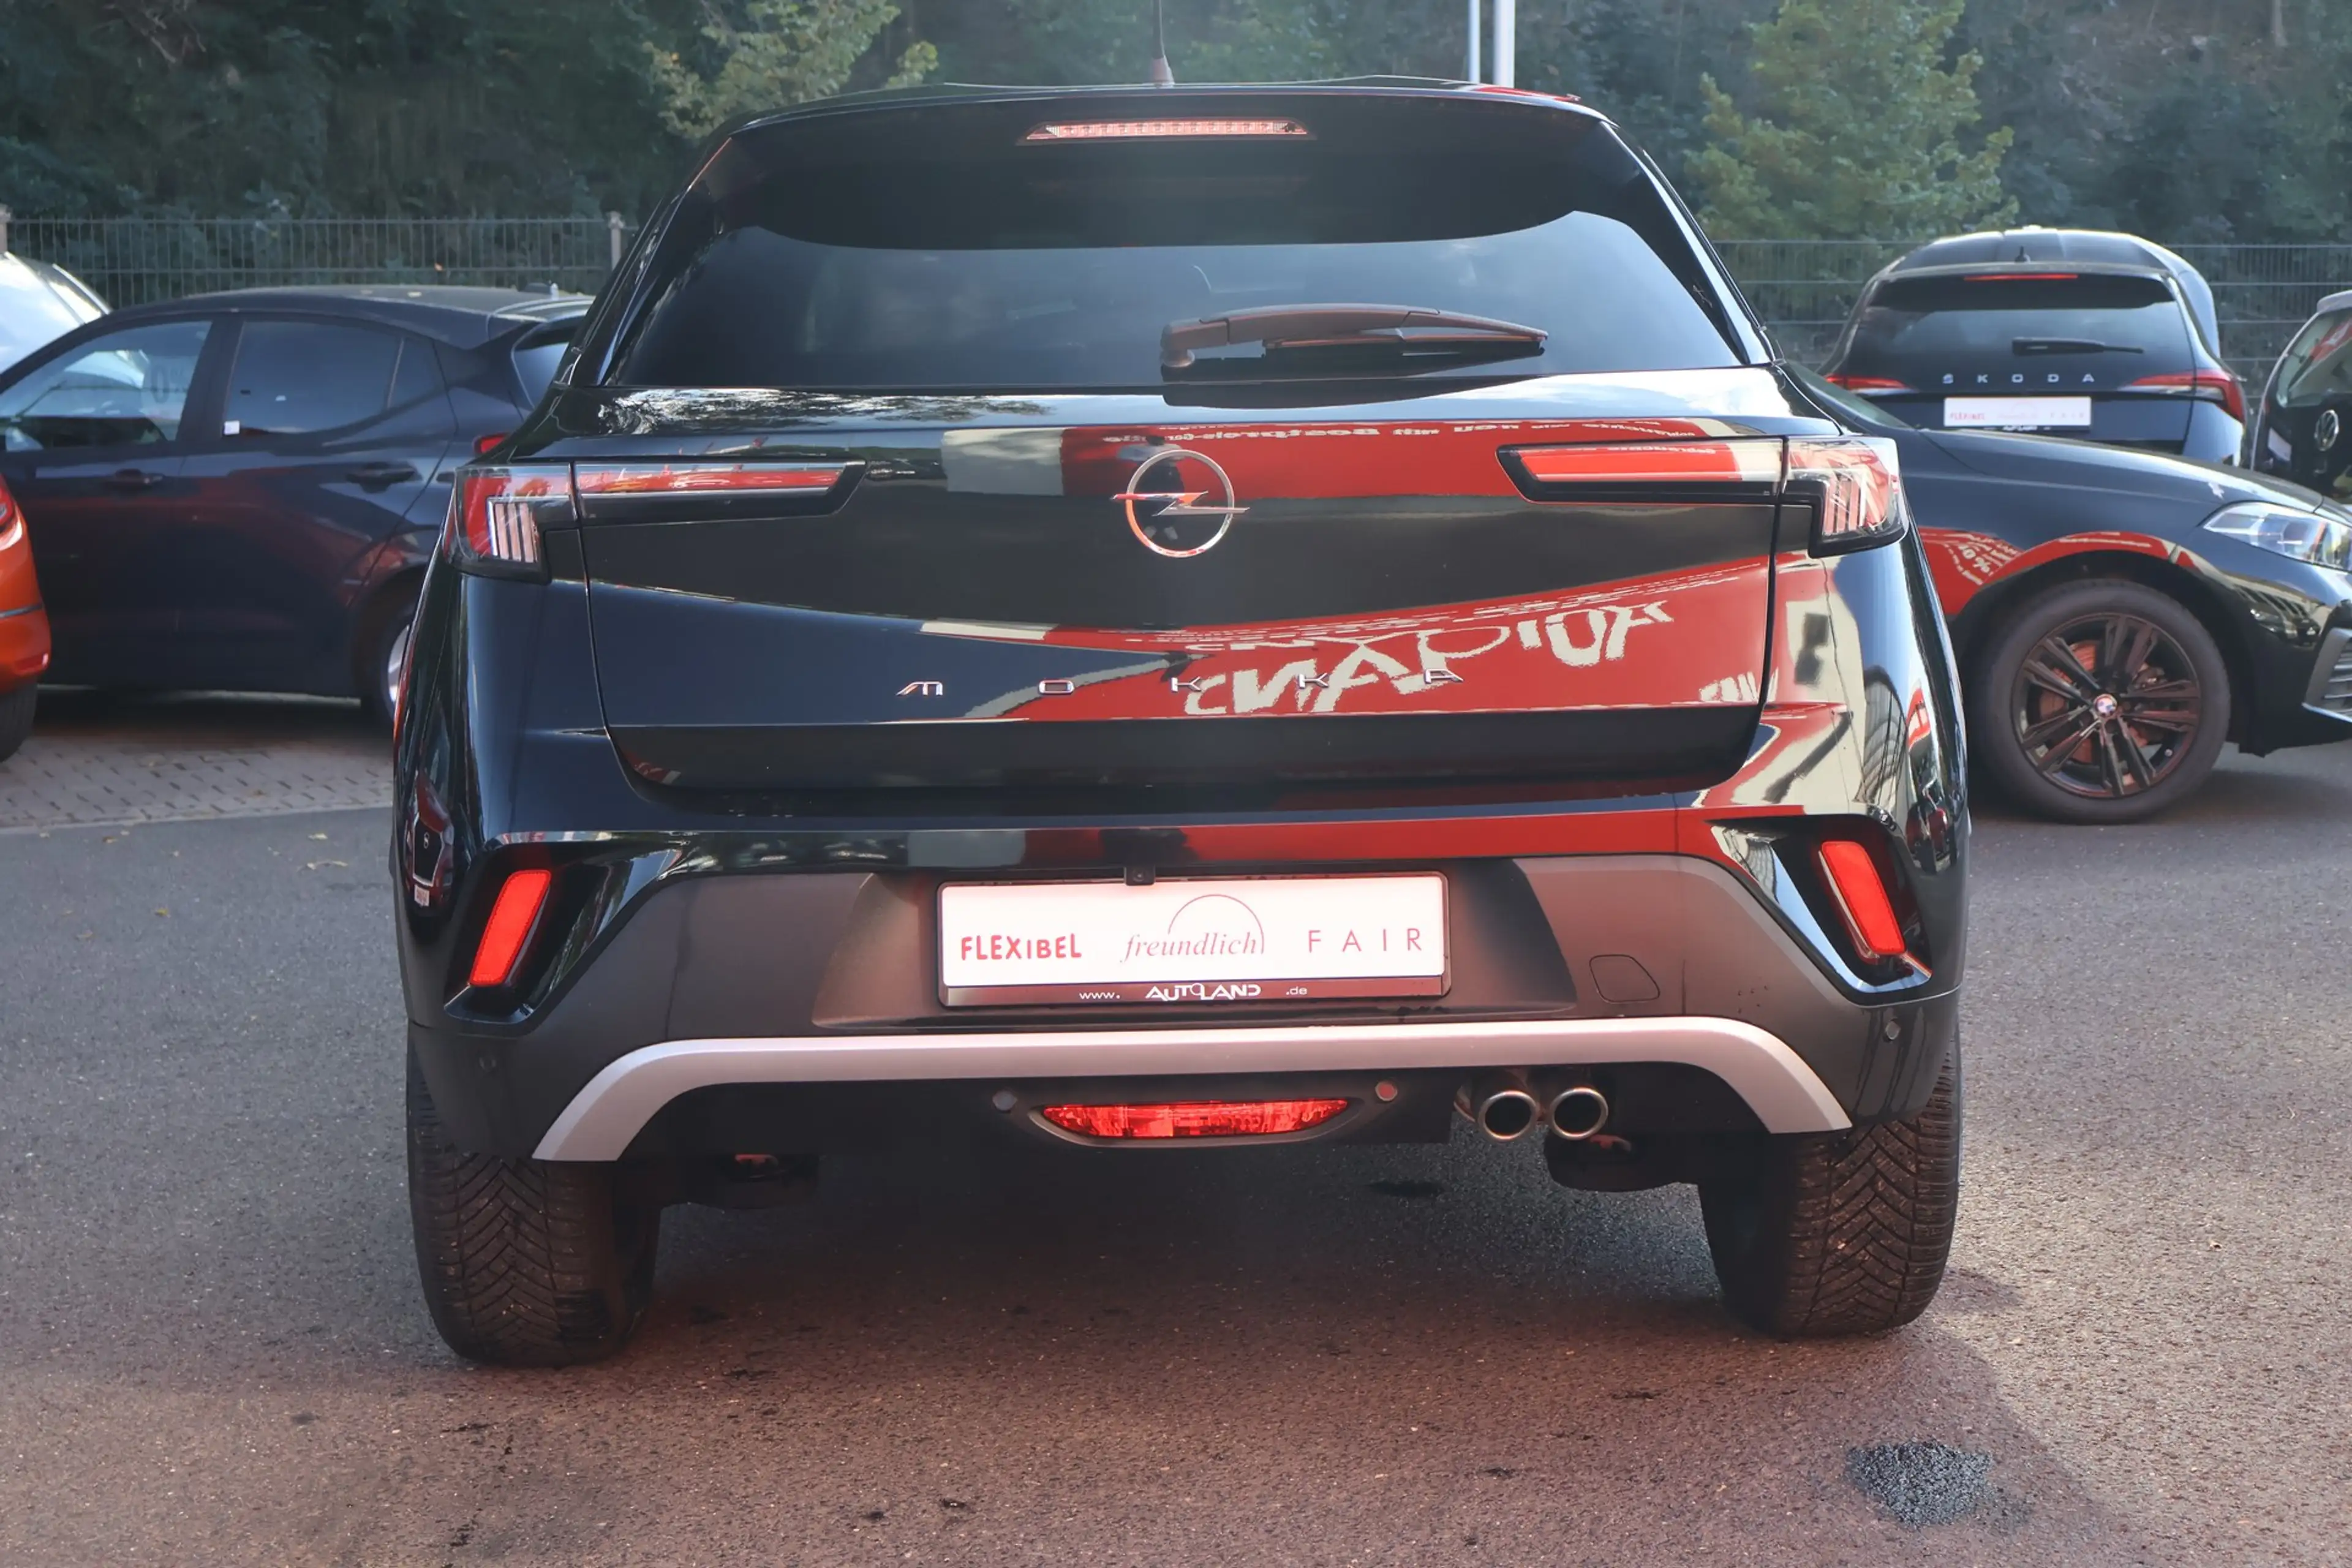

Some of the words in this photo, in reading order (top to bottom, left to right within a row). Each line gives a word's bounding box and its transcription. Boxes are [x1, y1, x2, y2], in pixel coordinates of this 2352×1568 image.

[1942, 373, 2095, 384] SKODA
[895, 668, 1464, 697] MOKKA
[961, 933, 1082, 960] FLEXIBEL
[1120, 931, 1257, 963] freundlich
[1308, 928, 1422, 953] FAIR
[1145, 982, 1262, 1002] AUTOLAND
